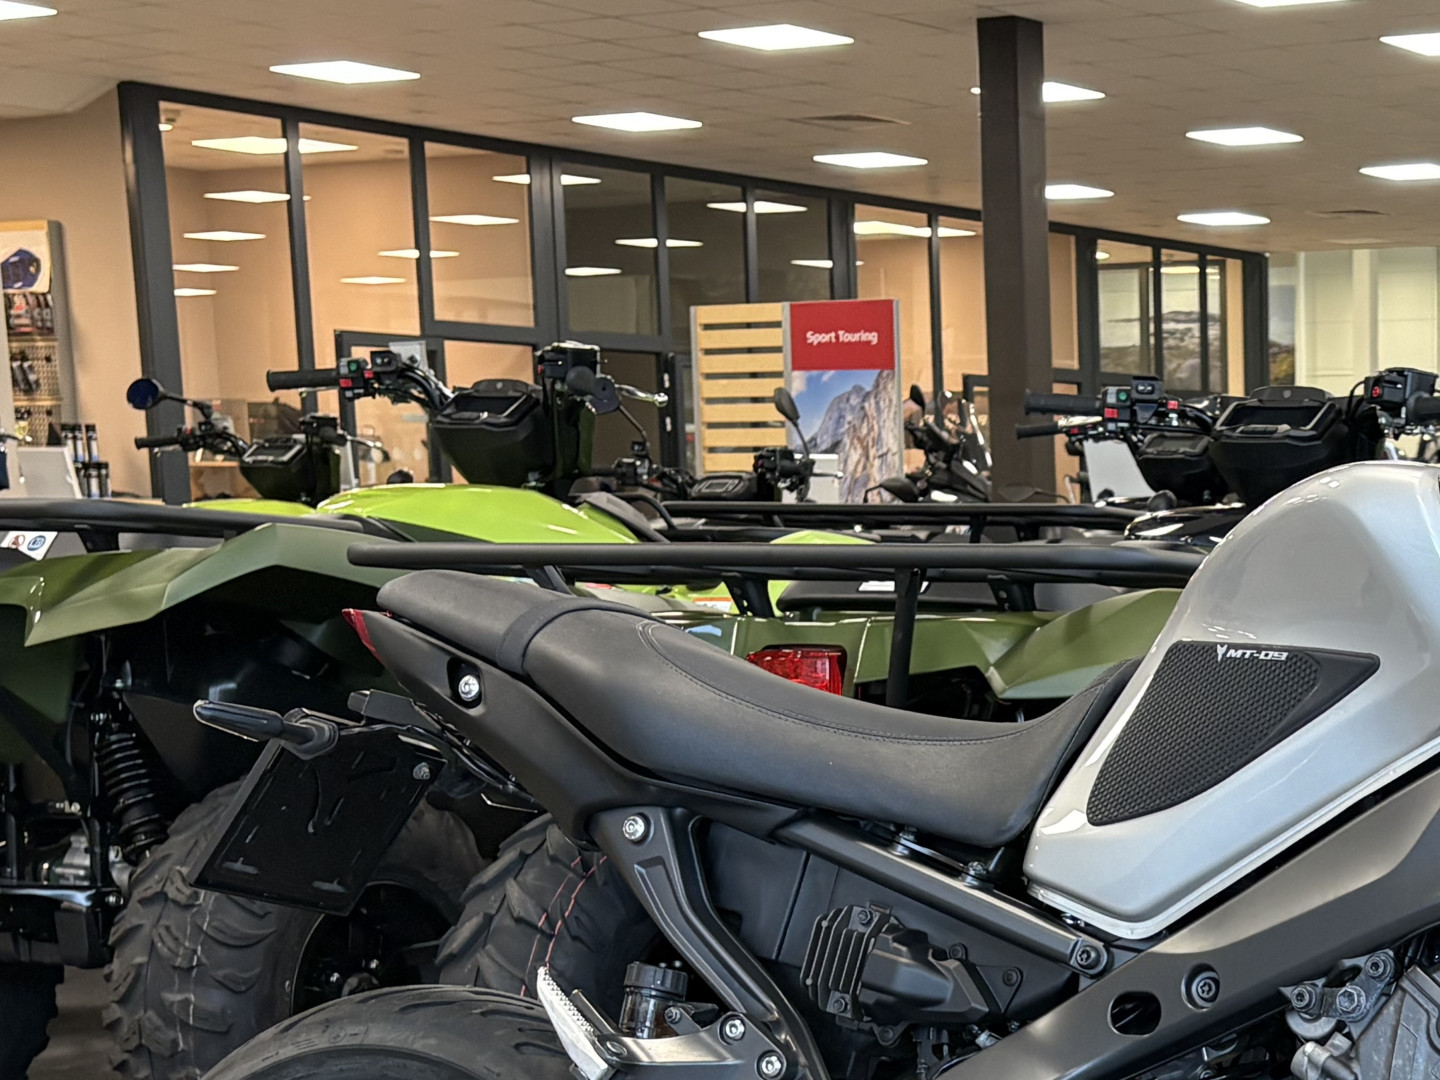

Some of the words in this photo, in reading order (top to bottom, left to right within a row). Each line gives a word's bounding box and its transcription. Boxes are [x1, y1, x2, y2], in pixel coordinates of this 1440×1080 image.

[806, 331, 836, 346] Sport
[837, 330, 878, 346] Touring
[1226, 649, 1289, 661] MT-09
